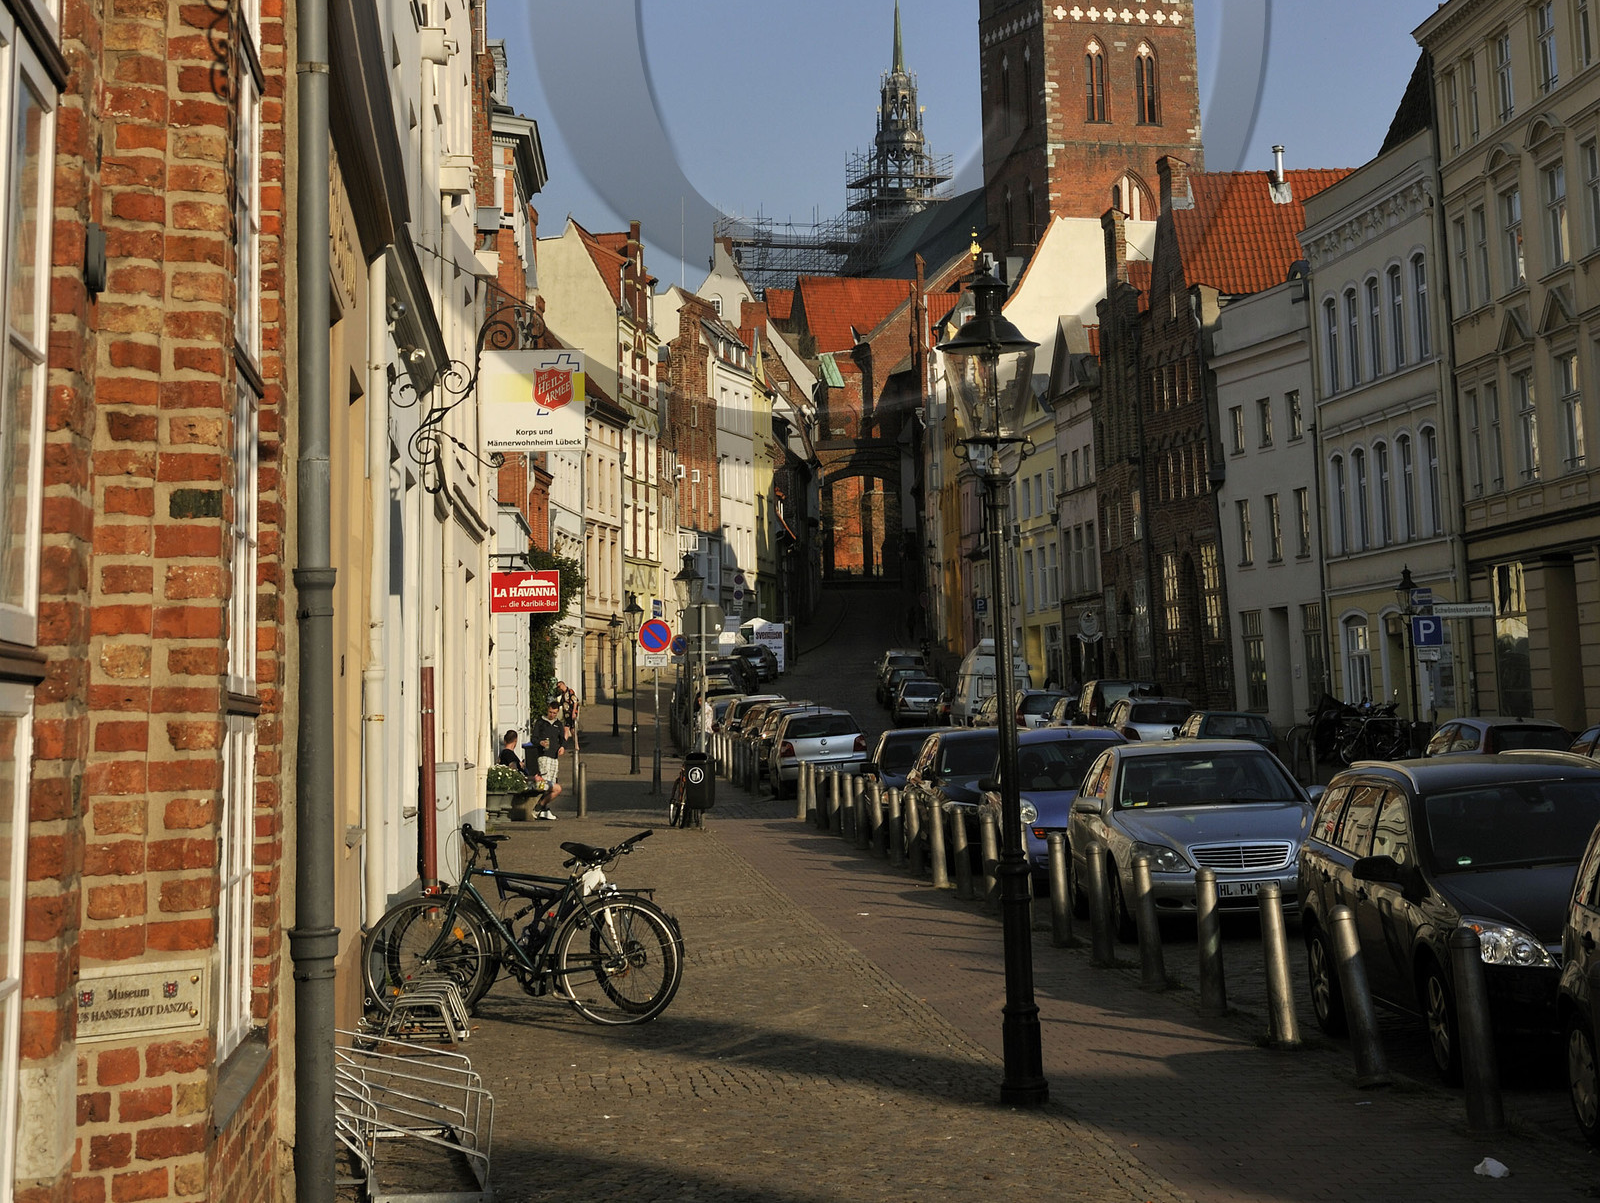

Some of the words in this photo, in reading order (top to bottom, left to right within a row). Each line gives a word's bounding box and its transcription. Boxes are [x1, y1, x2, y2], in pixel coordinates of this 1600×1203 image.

[537, 372, 549, 383] DIE
[543, 380, 571, 405] ARMEE
[487, 439, 553, 447] Männerwohnheim
[555, 438, 582, 446] Lübeck
[493, 587, 507, 598] LA
[509, 587, 557, 597] HAVANNA
[509, 600, 520, 608] die
[521, 599, 557, 607] Karibik-Bar
[1419, 620, 1435, 642] P
[1220, 884, 1233, 896] HL
[107, 989, 150, 1000] Museum
[91, 1005, 155, 1022] HANSESTADT
[156, 1001, 192, 1015] DANZIG
